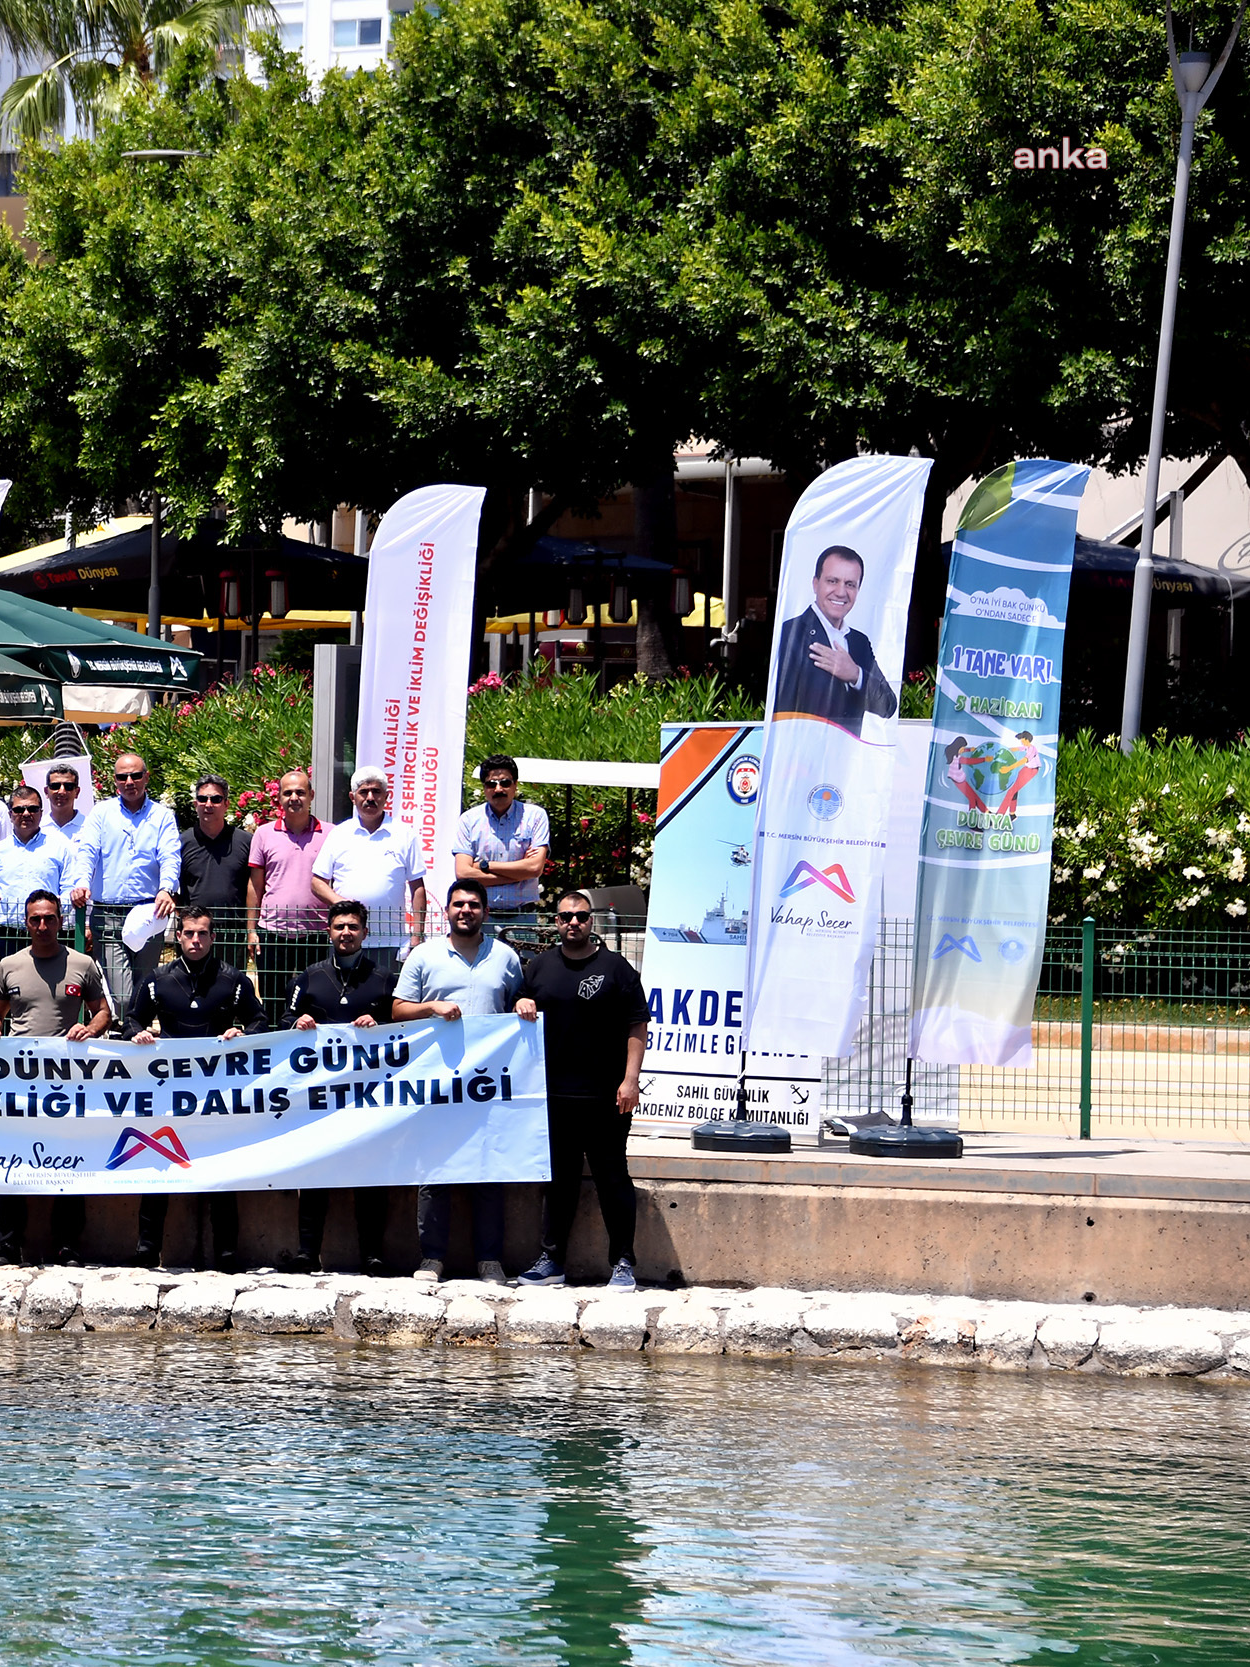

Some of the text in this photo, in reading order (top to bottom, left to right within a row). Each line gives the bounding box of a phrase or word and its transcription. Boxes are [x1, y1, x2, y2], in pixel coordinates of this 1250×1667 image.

[78, 566, 119, 580] Dünyası
[412, 542, 435, 642] DEĞİŞİKLİĞİ
[1152, 579, 1193, 594] ünyası
[970, 596, 1046, 613] O'NA İYİ BAK ÇÜNKÜ
[975, 608, 1037, 624] O'NDAN SADECE
[406, 648, 425, 693] İKLİM
[953, 645, 1052, 683] 1 TANE VAR!
[407, 696, 421, 717] VE
[954, 695, 1043, 719] 5 HAZİRAN
[383, 698, 401, 769] VALİLİĞİ
[400, 721, 419, 811] ŞEHİRCİLİK
[419, 747, 439, 852] MÜDÜRLÜĞÜ
[957, 809, 1013, 830] DÜNYA
[778, 833, 802, 841] MERSİN
[803, 835, 845, 845] BÜYÜKŞEHİR
[845, 840, 880, 848] BELEDİYESİ
[936, 829, 1041, 852] ÇEVRE GÜNÜ
[770, 905, 814, 935] Vahap
[149, 1047, 272, 1086] ÇEVRE
[289, 1034, 411, 1075] GÜNÜ
[103, 1091, 155, 1118] VE
[171, 1087, 291, 1119] DALIŞ
[308, 1066, 513, 1111] ETKİNLİĞİ
[676, 1083, 770, 1104] SAHİL GÜVNLİK
[635, 1101, 809, 1126] AKDENİZ BÖLGE KMUTANLIĞI
[28, 1141, 85, 1171] Seçer
